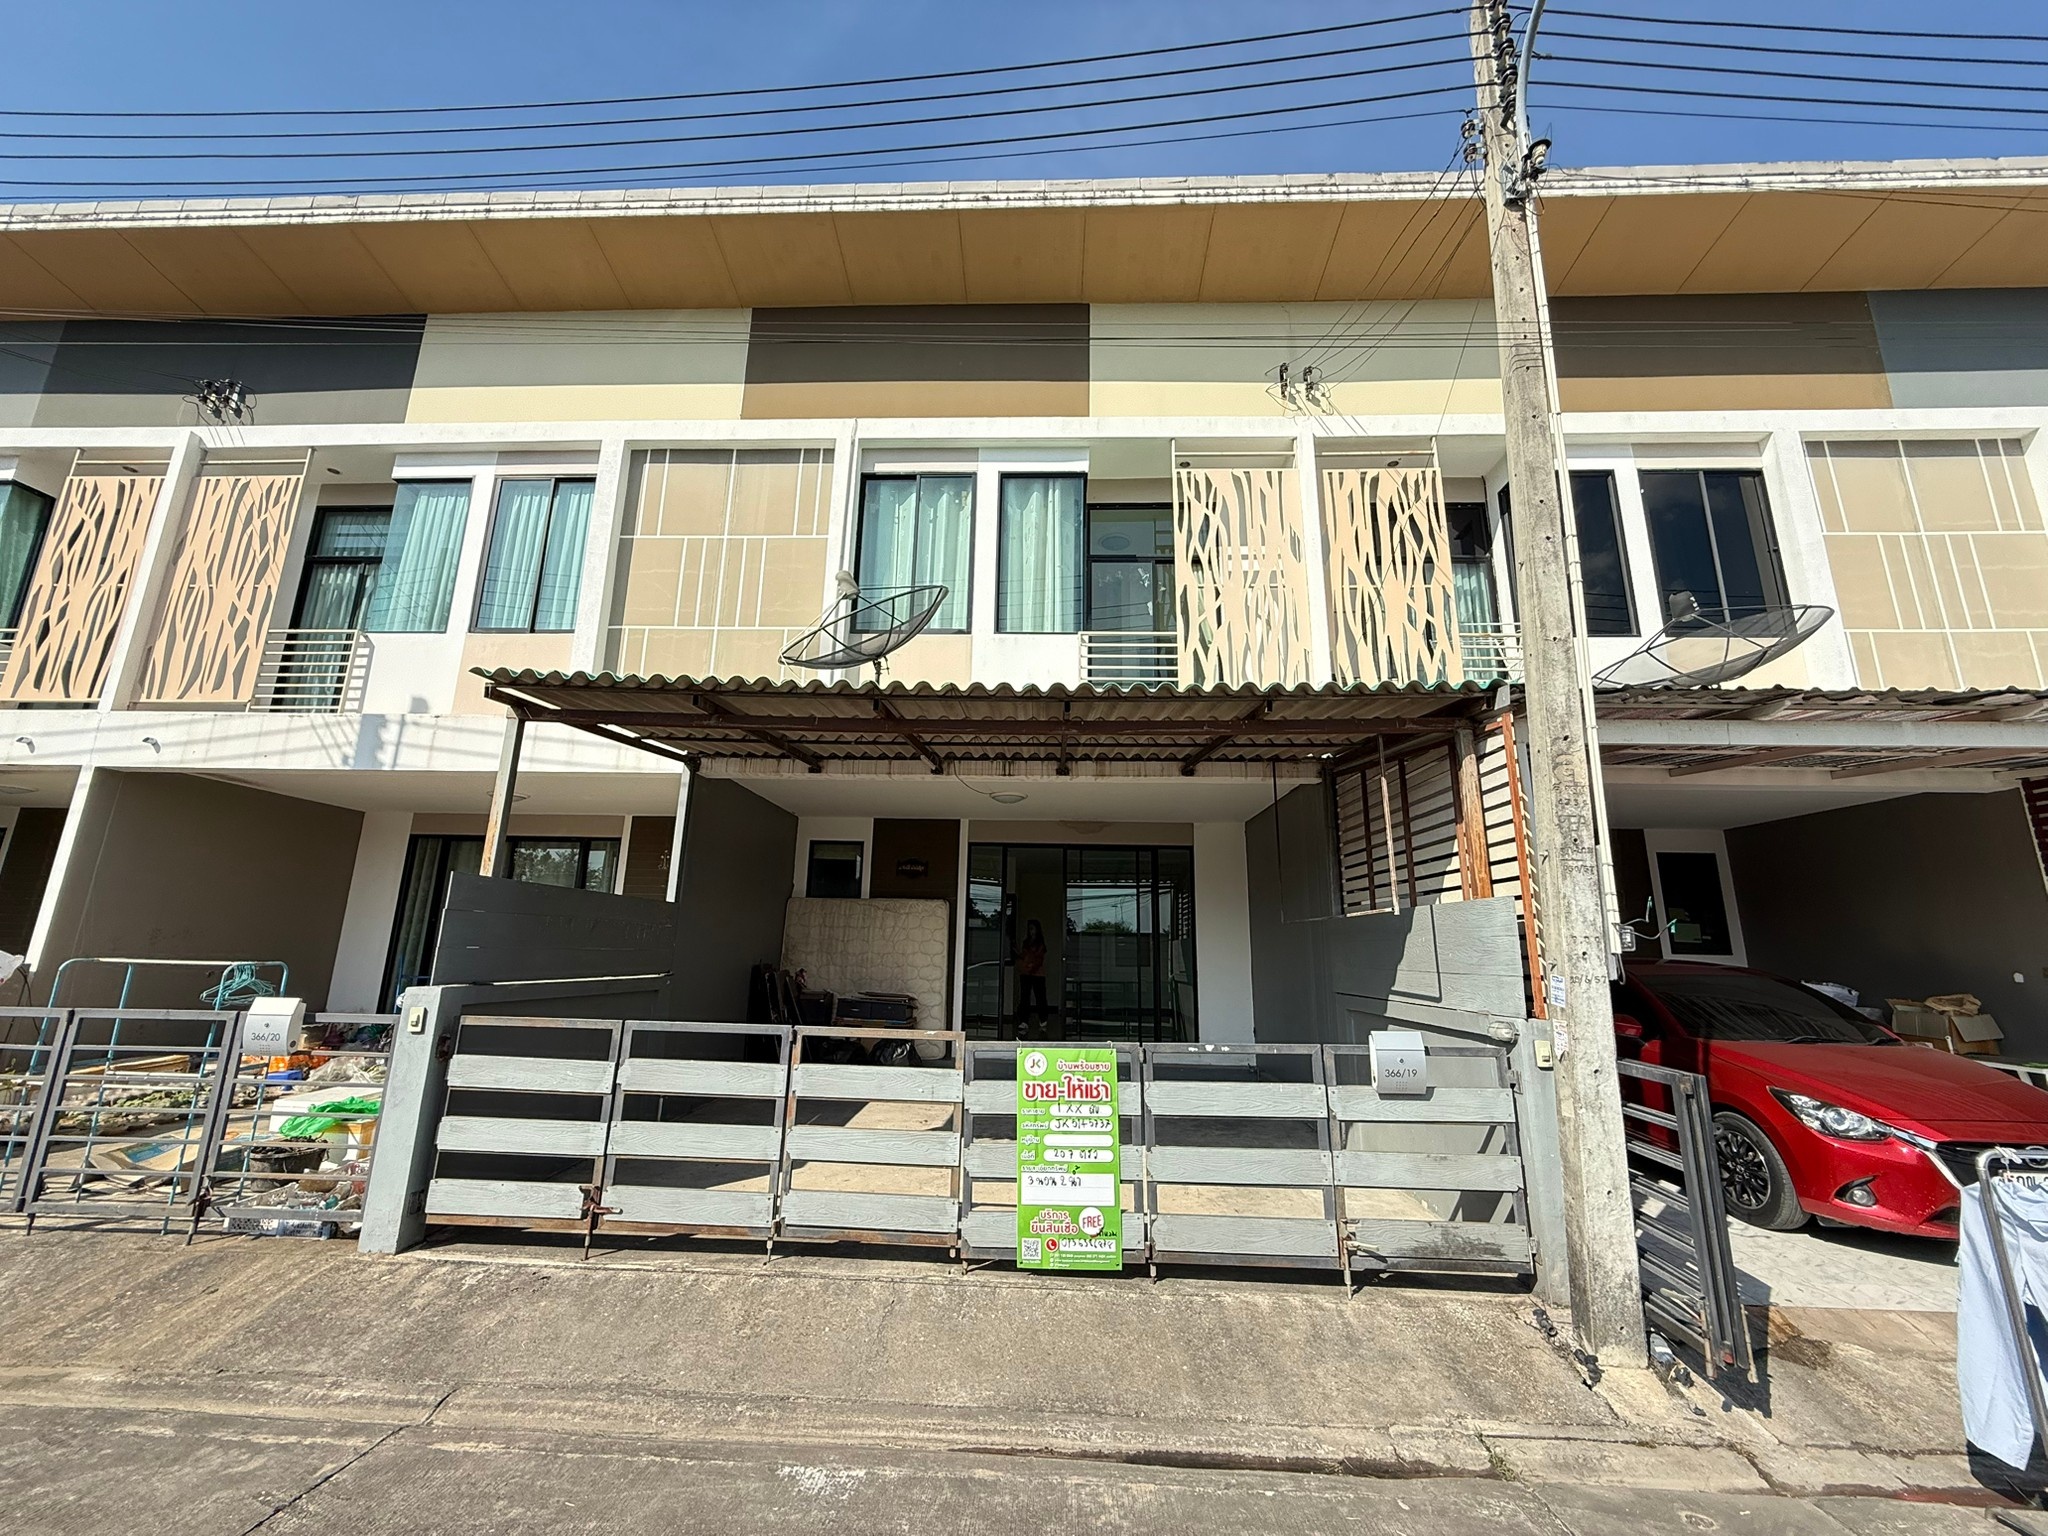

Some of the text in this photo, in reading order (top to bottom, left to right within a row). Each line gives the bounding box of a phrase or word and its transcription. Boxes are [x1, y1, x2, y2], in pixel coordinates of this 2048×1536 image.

[251, 1032, 281, 1041] 366/20
[1030, 1059, 1041, 1069] JK
[1384, 1068, 1418, 1078] 366/19
[1024, 1075, 1110, 1100] ขาย-ให้เช่า
[1082, 1214, 1102, 1229] FREE
